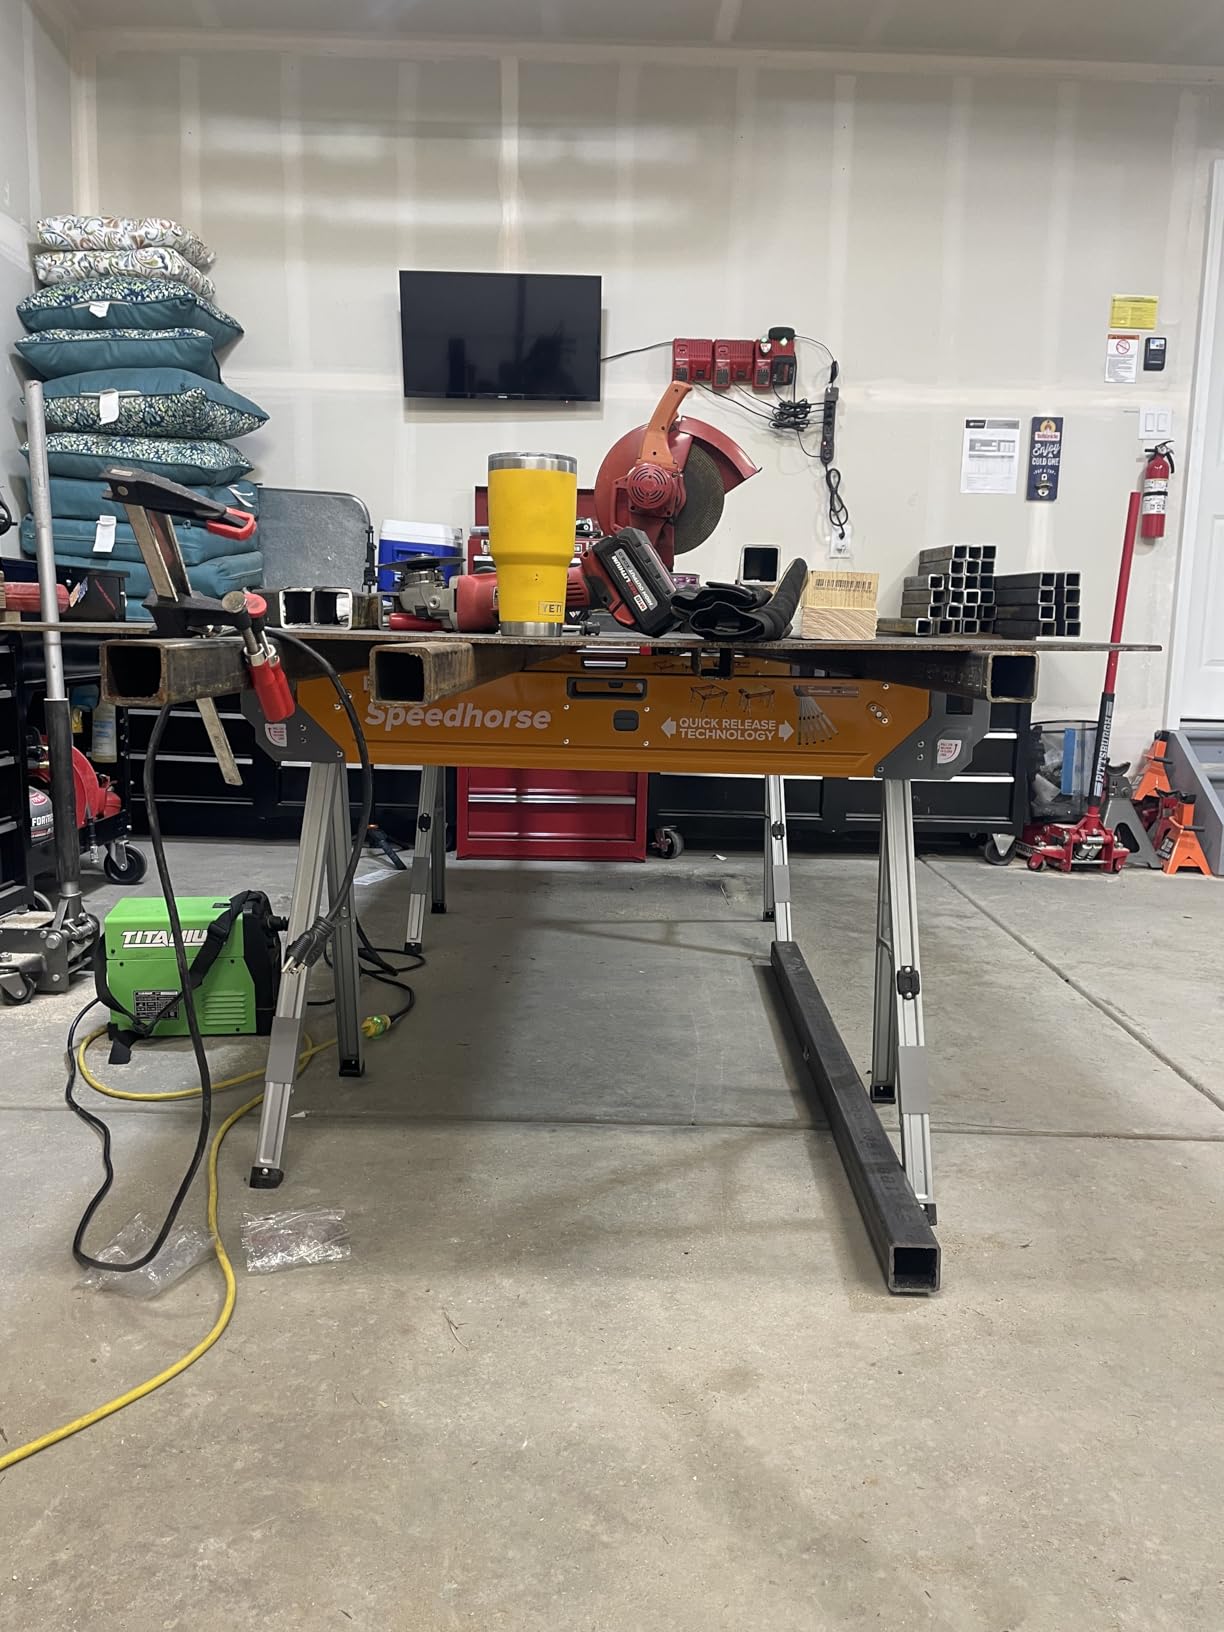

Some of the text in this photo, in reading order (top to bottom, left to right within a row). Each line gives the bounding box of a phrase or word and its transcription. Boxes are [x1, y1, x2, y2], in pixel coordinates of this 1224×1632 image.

[1033, 443, 1060, 456] Enjoy
[1032, 457, 1046, 465] COLD
[628, 567, 644, 591] OUTPUT
[643, 591, 654, 606] HIGH
[541, 604, 562, 613] YETI
[365, 702, 552, 731] Speedhorse
[679, 718, 776, 730] QUICK RELEASE
[679, 729, 776, 741] TECHNOLOGY
[1096, 716, 1112, 783] PITTSBURGH
